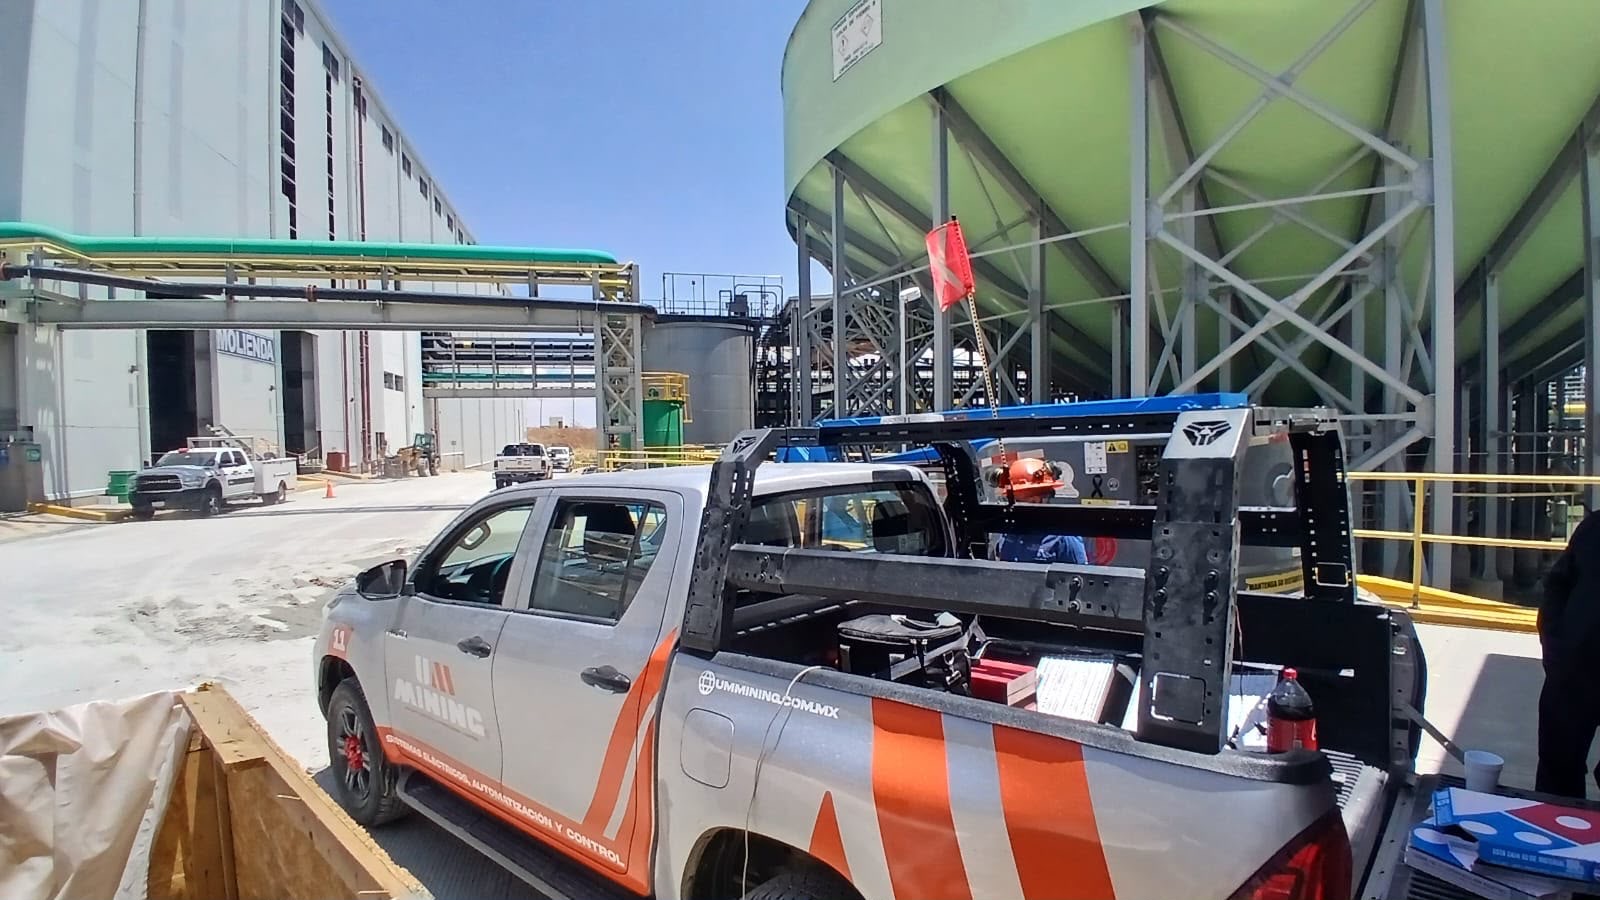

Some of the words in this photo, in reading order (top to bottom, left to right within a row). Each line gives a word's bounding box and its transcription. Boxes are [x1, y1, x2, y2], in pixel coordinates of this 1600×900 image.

[217, 329, 275, 362] MOLIENDA
[332, 628, 346, 652] 11
[394, 678, 486, 737] MINING
[715, 678, 840, 719] UMMINING.COM.MX
[385, 733, 423, 757] SISTEMAS
[554, 821, 564, 833] Y
[566, 828, 625, 867] CONTROL
